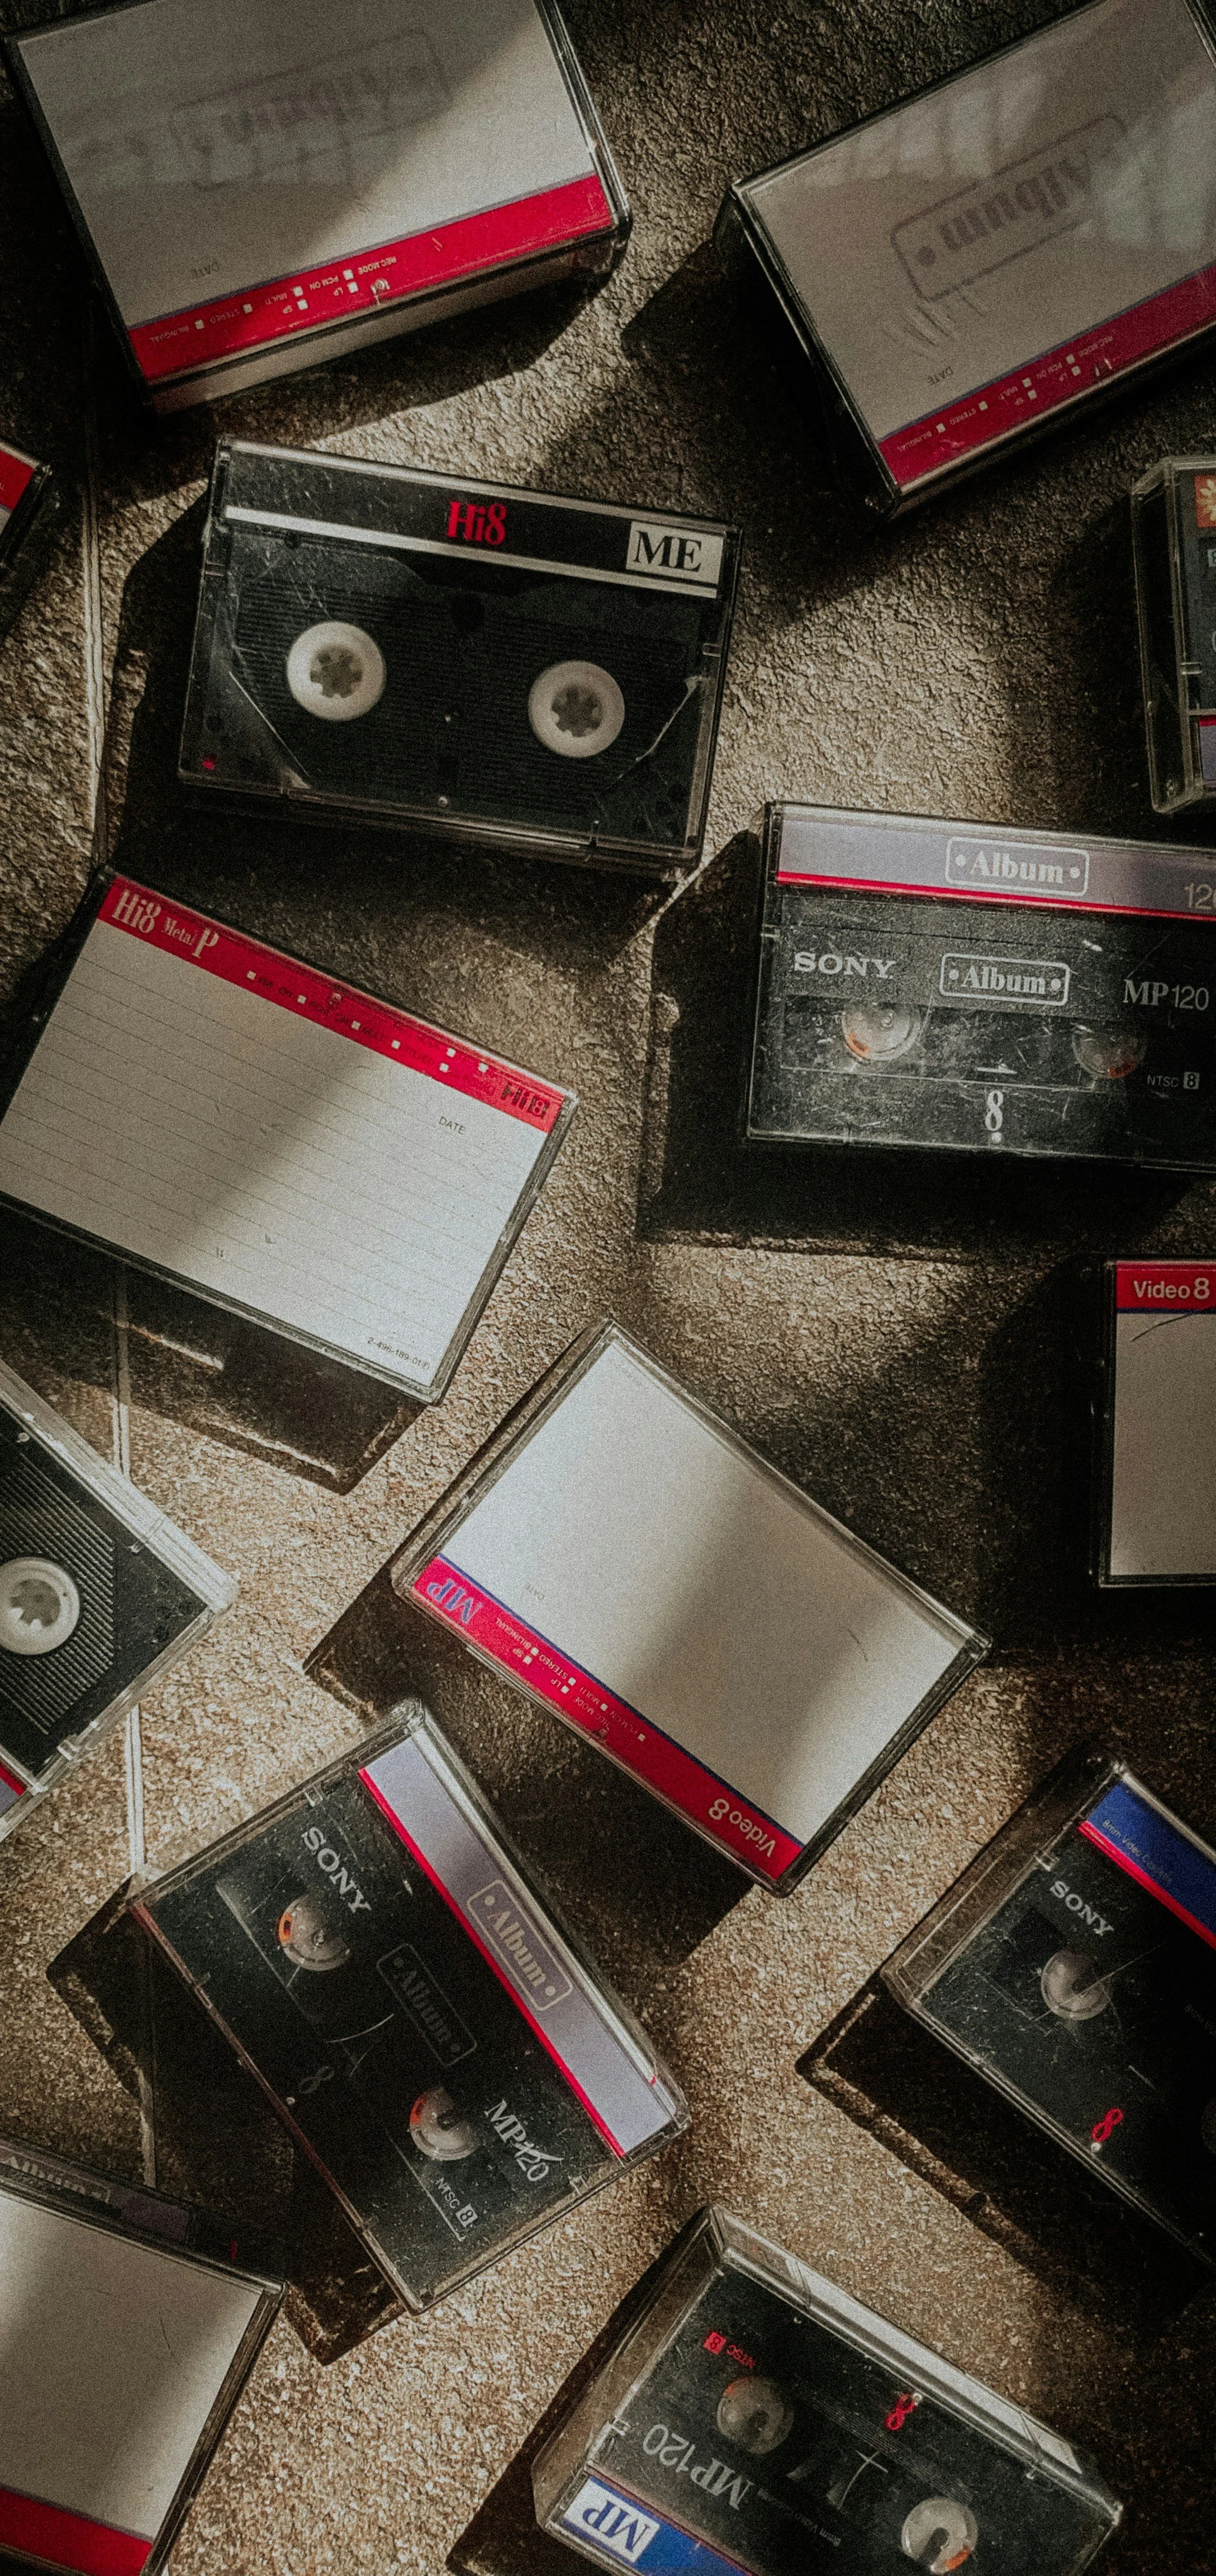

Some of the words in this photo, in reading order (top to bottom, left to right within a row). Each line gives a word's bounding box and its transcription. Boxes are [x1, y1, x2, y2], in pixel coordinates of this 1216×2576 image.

[939, 155, 1095, 252] Album
[308, 280, 321, 290] ON
[208, 307, 240, 324] STEREO
[925, 365, 954, 386] DATE
[948, 406, 977, 426] STEREO
[447, 500, 507, 546] Hi8
[634, 531, 702, 574] ME
[970, 851, 1065, 884] Album
[1184, 882, 1216, 911] 12
[113, 889, 162, 935] Hi8
[193, 927, 220, 959] P
[794, 952, 894, 979] SONY
[960, 967, 1047, 995] Album
[1147, 1075, 1180, 1088] NTSC
[438, 1115, 467, 1135] DATE
[984, 1090, 1004, 1132] 8
[1133, 1281, 1190, 1299] Video
[1194, 1277, 1210, 1300] 8
[426, 1583, 483, 1626] MP
[492, 1617, 533, 1649] BILINGUAL
[511, 1646, 524, 1658] SP
[537, 1653, 569, 1680] STEREO
[549, 1677, 562, 1688] LP
[707, 1797, 733, 1822] 8
[723, 1810, 775, 1857] Video
[1101, 1818, 1123, 1839] 8mm
[1119, 1835, 1144, 1858] Video
[301, 1826, 372, 1915] SONY
[1048, 1880, 1115, 1938] SONY
[488, 1907, 545, 1987] Album
[395, 1967, 454, 2045] Album
[298, 2065, 335, 2095] 8
[1091, 2108, 1124, 2143] 8
[435, 2177, 460, 2208] NTSC
[725, 2343, 756, 2370] NTSC
[581, 2499, 651, 2554] MP
